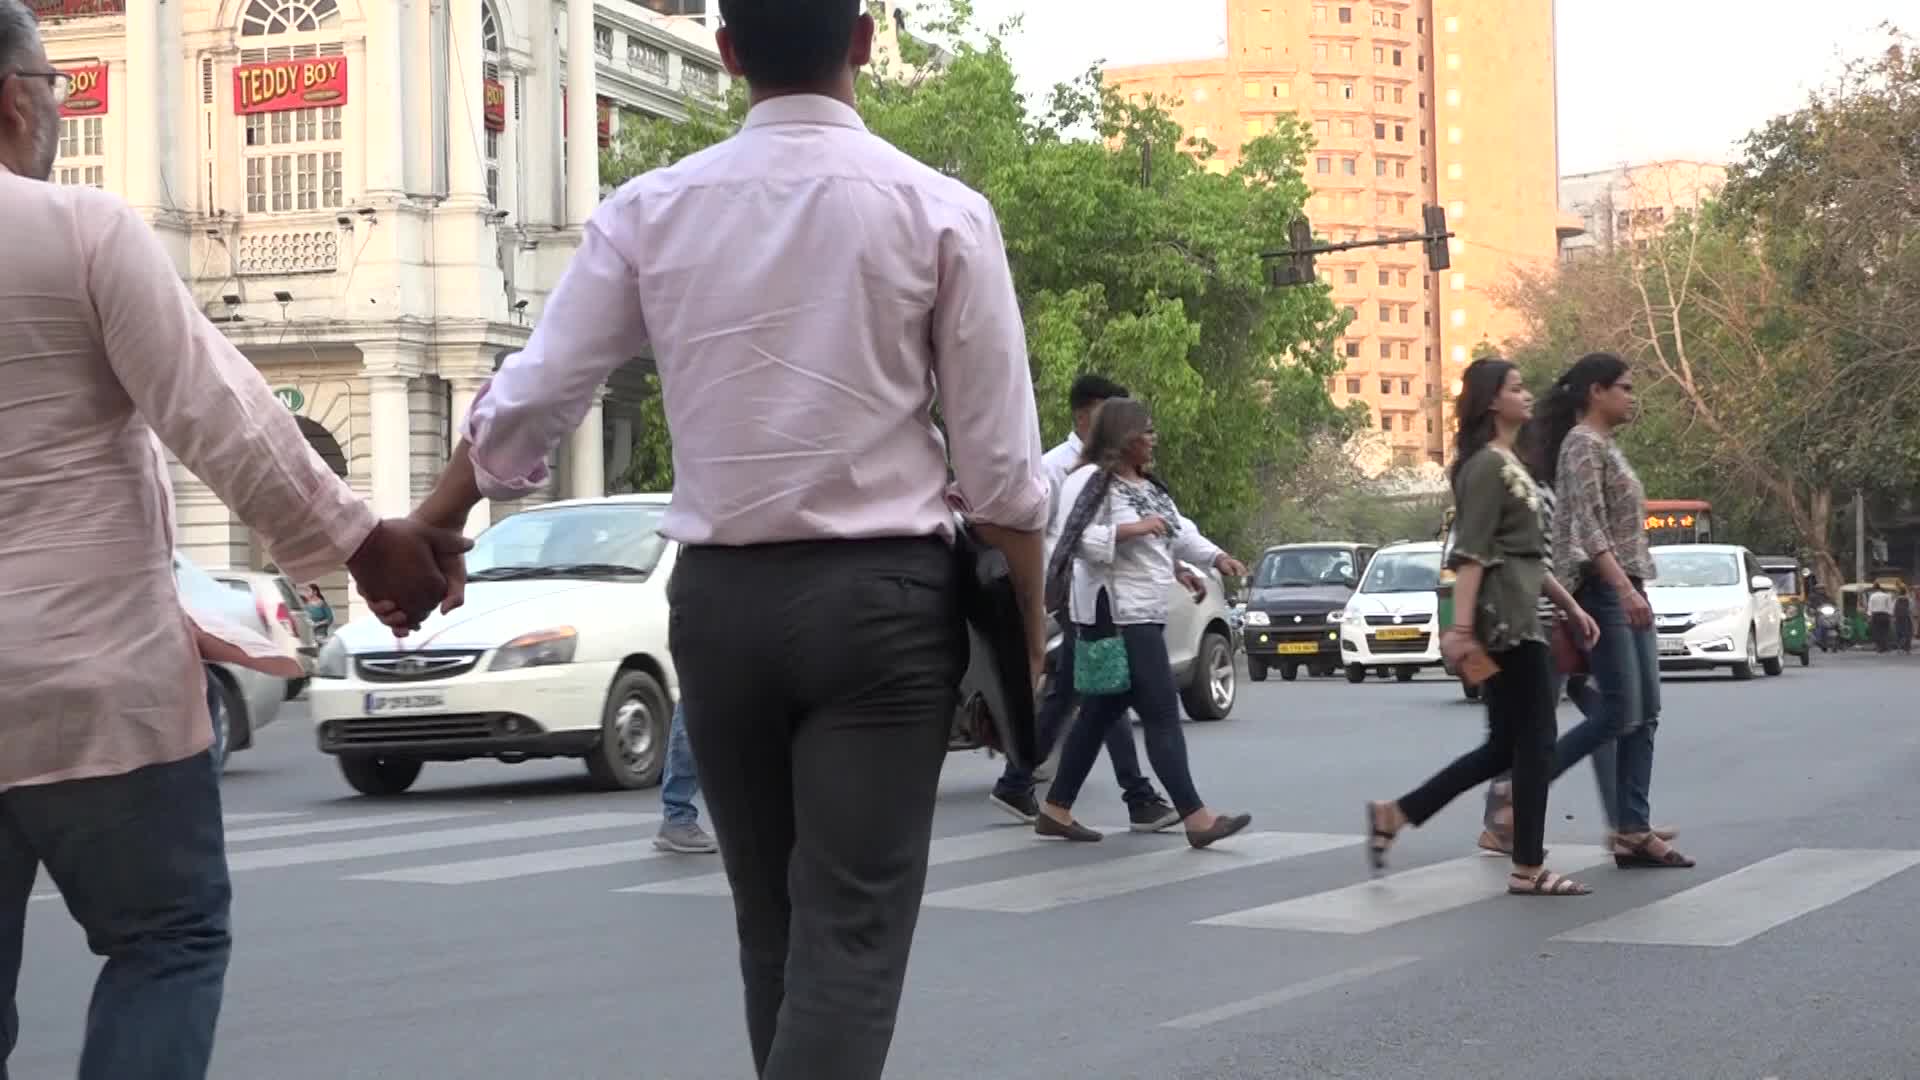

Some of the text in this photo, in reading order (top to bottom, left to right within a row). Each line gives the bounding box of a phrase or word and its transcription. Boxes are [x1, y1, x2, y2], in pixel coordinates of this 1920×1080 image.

[67, 71, 98, 96] BOY
[239, 61, 338, 106] TEDDY BOY
